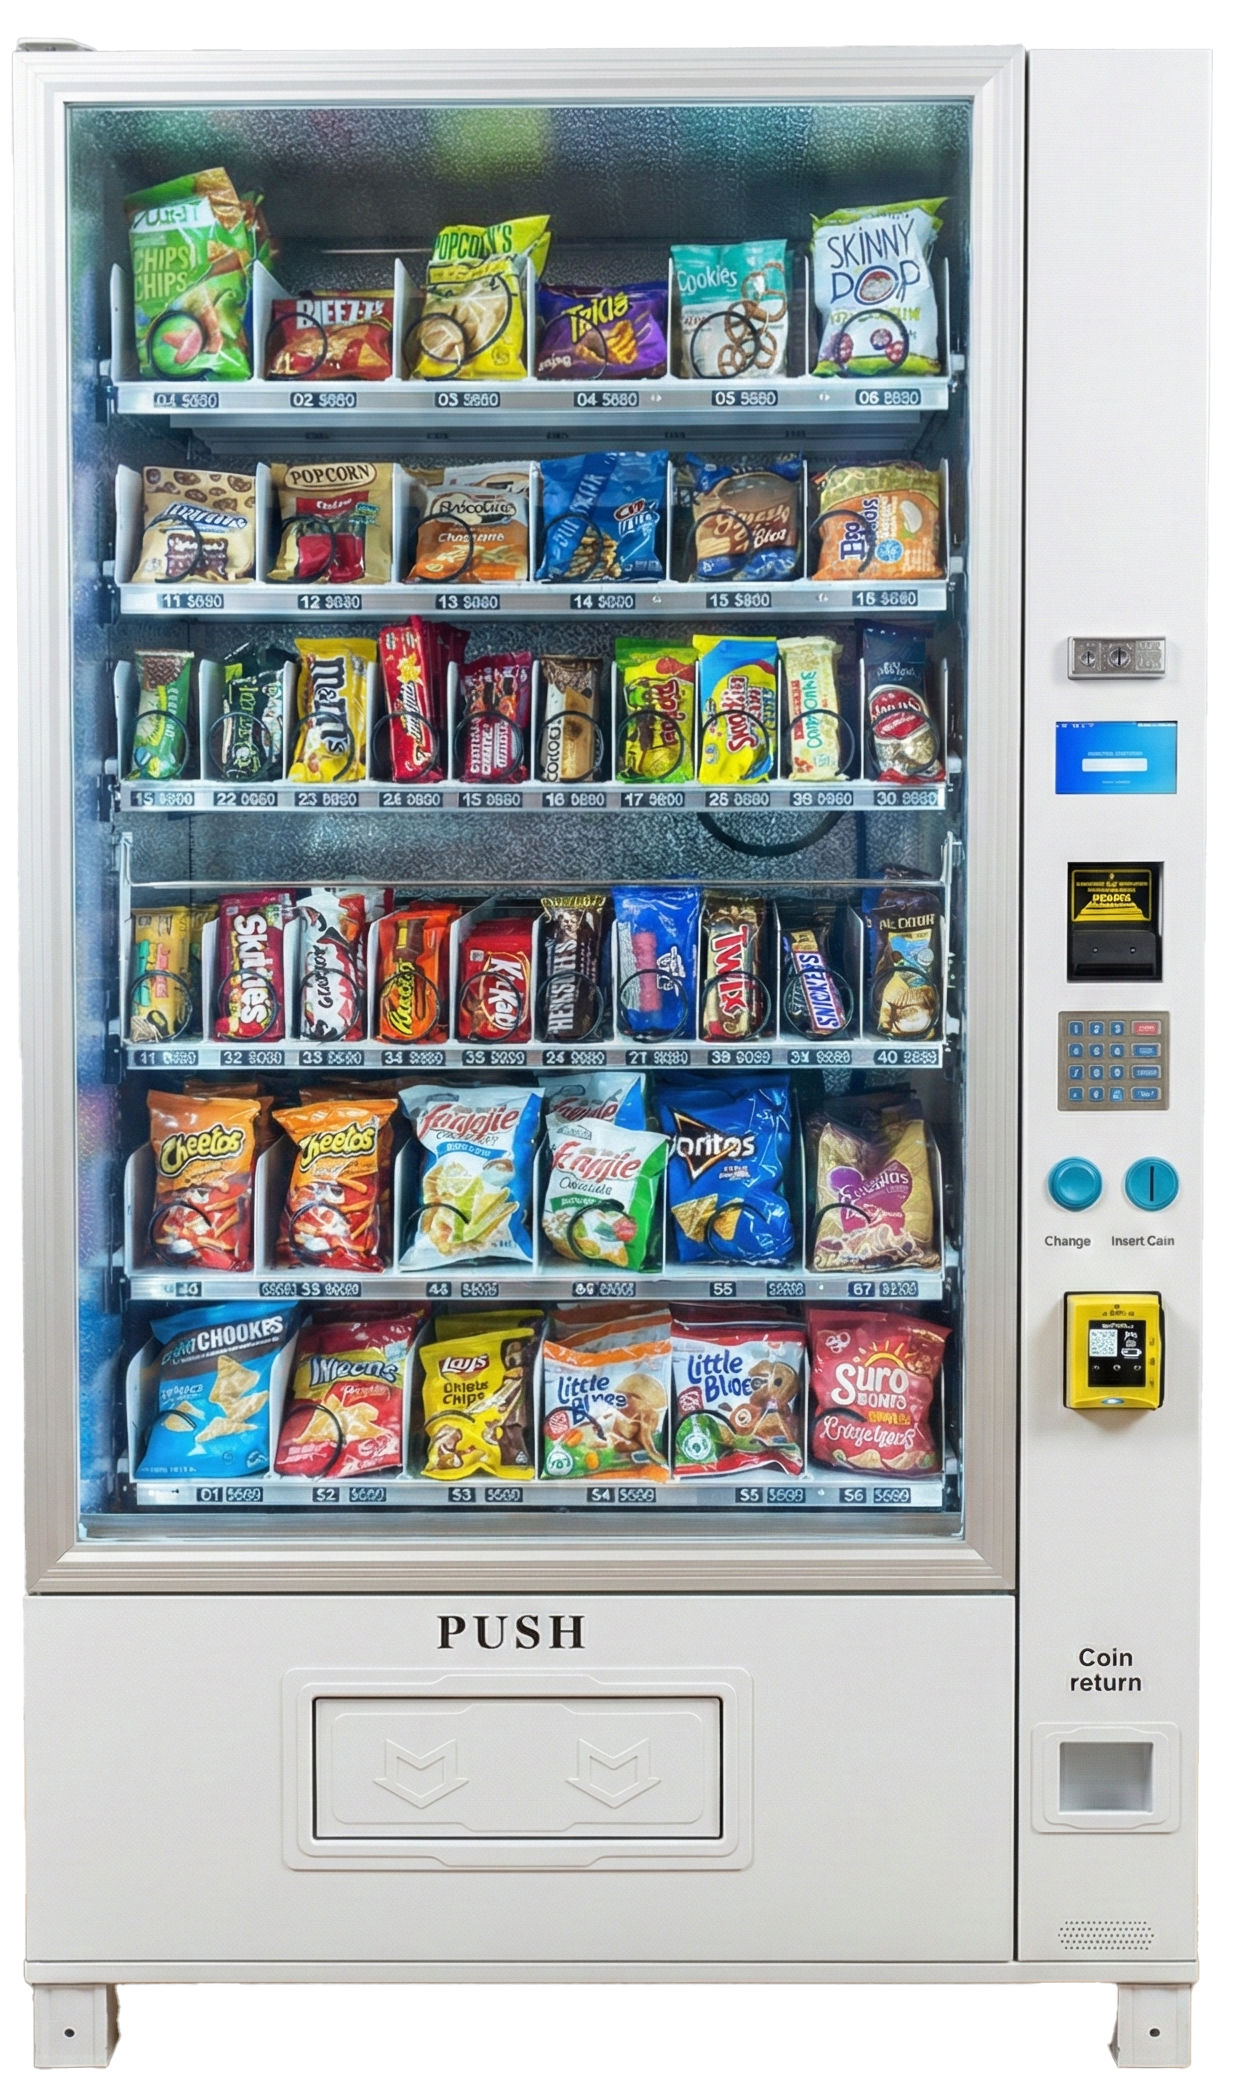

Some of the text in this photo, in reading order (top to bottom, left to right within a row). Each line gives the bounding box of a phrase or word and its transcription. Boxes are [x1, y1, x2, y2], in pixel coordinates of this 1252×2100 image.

[827, 219, 914, 269] SKINNY
[293, 393, 314, 407] 02
[577, 393, 597, 406] 04
[858, 391, 880, 405] 06
[291, 464, 371, 486] POPCORN
[300, 595, 320, 609] 12
[438, 595, 458, 609] 13
[710, 593, 729, 607] 15
[217, 793, 236, 806] 22
[546, 793, 565, 806] 16
[625, 793, 643, 806] 17
[877, 792, 896, 805] 30
[224, 1051, 242, 1064] 32
[877, 1050, 898, 1063] 40
[162, 1126, 244, 1174] Cheetos
[1044, 1235, 1091, 1249] Change
[1111, 1235, 1145, 1247] Insert
[853, 1282, 872, 1295] 67
[831, 1363, 909, 1405] Suro
[437, 1614, 586, 1650] PUSH
[1079, 1647, 1133, 1667] Coin
[1070, 1673, 1142, 1691] return
